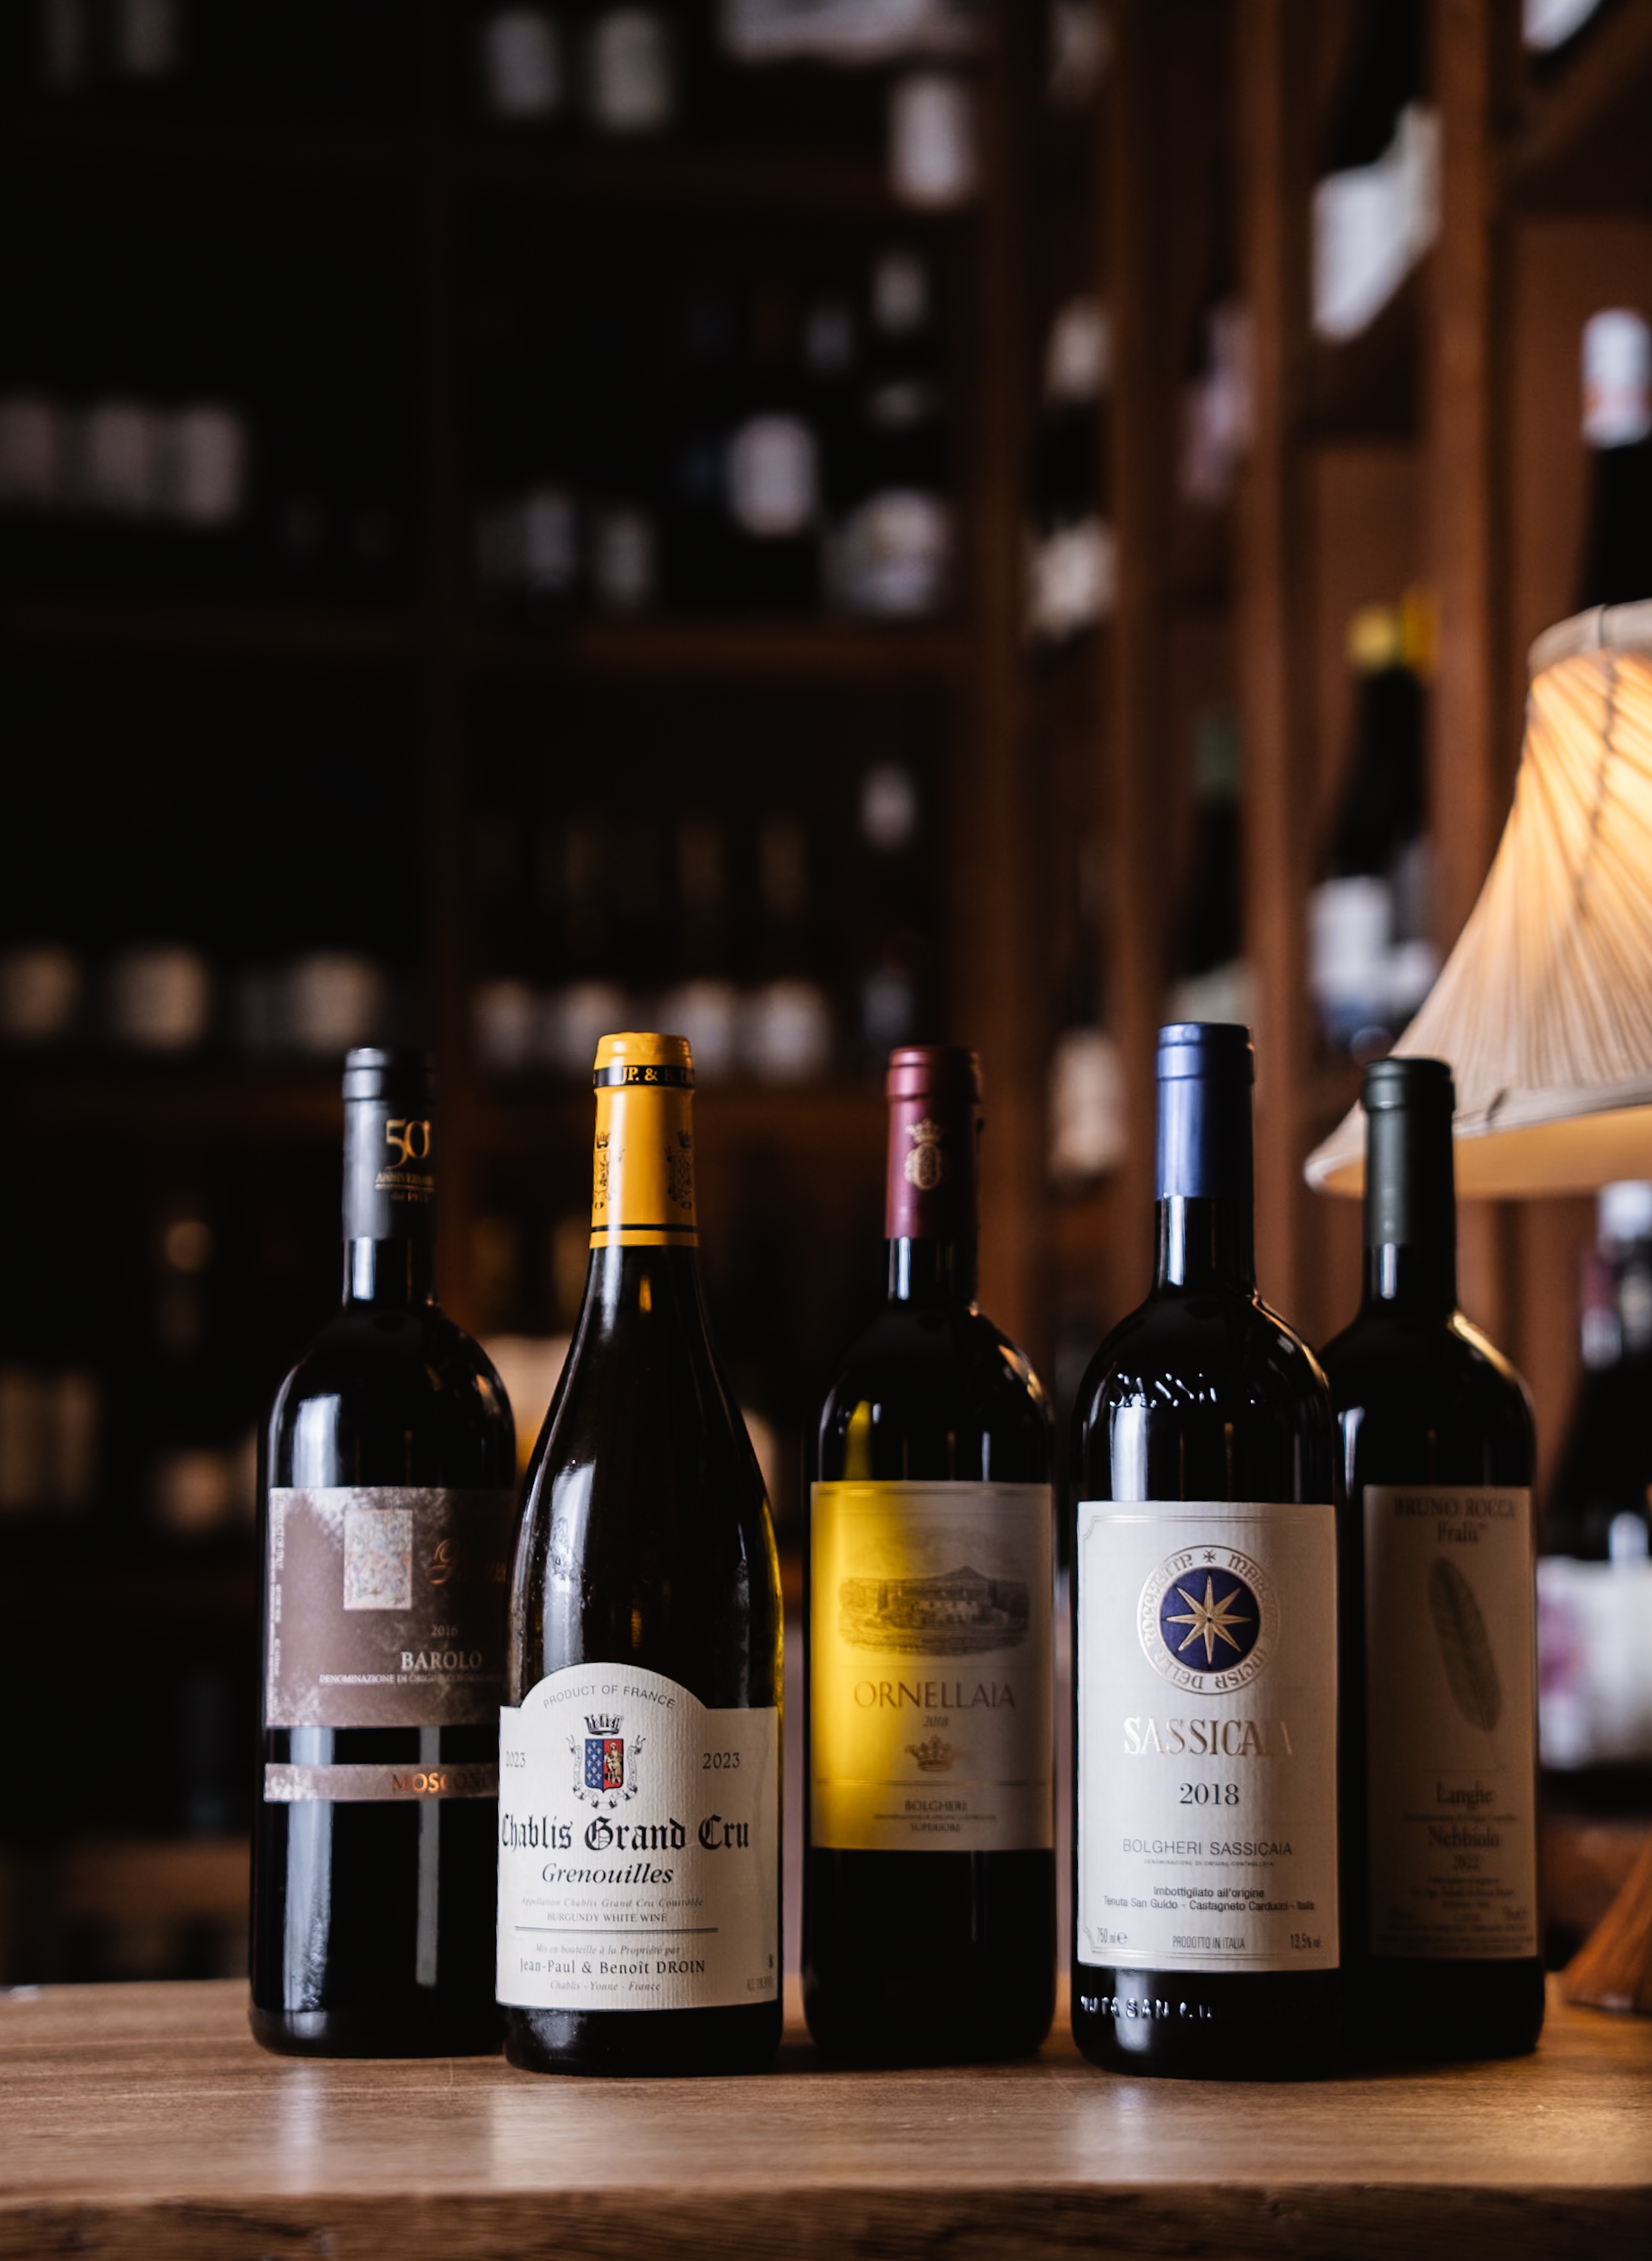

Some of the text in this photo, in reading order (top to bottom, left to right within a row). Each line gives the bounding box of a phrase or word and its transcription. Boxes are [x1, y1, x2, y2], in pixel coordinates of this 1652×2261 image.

[644, 1067, 658, 1082] &
[1394, 1495, 1459, 1518] BRUNO
[401, 1651, 482, 1671] BAROLO
[543, 1685, 677, 1709] PRODUCT OF FRANCE
[854, 1680, 1016, 1709] ORNELLAIA
[505, 1752, 526, 1768] 2023
[702, 1752, 740, 1770] 2023
[1179, 1783, 1239, 1805] 2018
[1436, 1780, 1495, 1811] Langhe
[502, 1813, 750, 1852] Chablis Grand Cru
[1427, 1824, 1501, 1848] Nebbiolo
[1122, 1839, 1293, 1856] BOLGHERI SASSICAIA
[542, 1862, 674, 1884] Grenouilles
[1153, 1886, 1265, 1899] Imbottigliato all'origine
[564, 1897, 597, 1907] Chablis
[601, 1898, 632, 1907] Grand
[636, 1898, 654, 1907] Cru
[1103, 1896, 1128, 1907] Tenuta
[1131, 1897, 1147, 1907] San
[1150, 1899, 1178, 1909] Guido
[1189, 1899, 1246, 1913] Castagneto
[547, 1912, 668, 1922] BURGUNDY WHITE WINE
[1097, 1927, 1108, 1943] 750
[1173, 1935, 1245, 1949] PRODOTTO IN ITALIA
[561, 1944, 595, 1954] bouteille
[608, 1946, 616, 1954] la
[520, 1957, 706, 1974] Jean-Paul & Benoît DROIN
[550, 1980, 580, 1990] Chablis
[590, 1982, 618, 1991] Yonne
[628, 1982, 662, 1991] France
